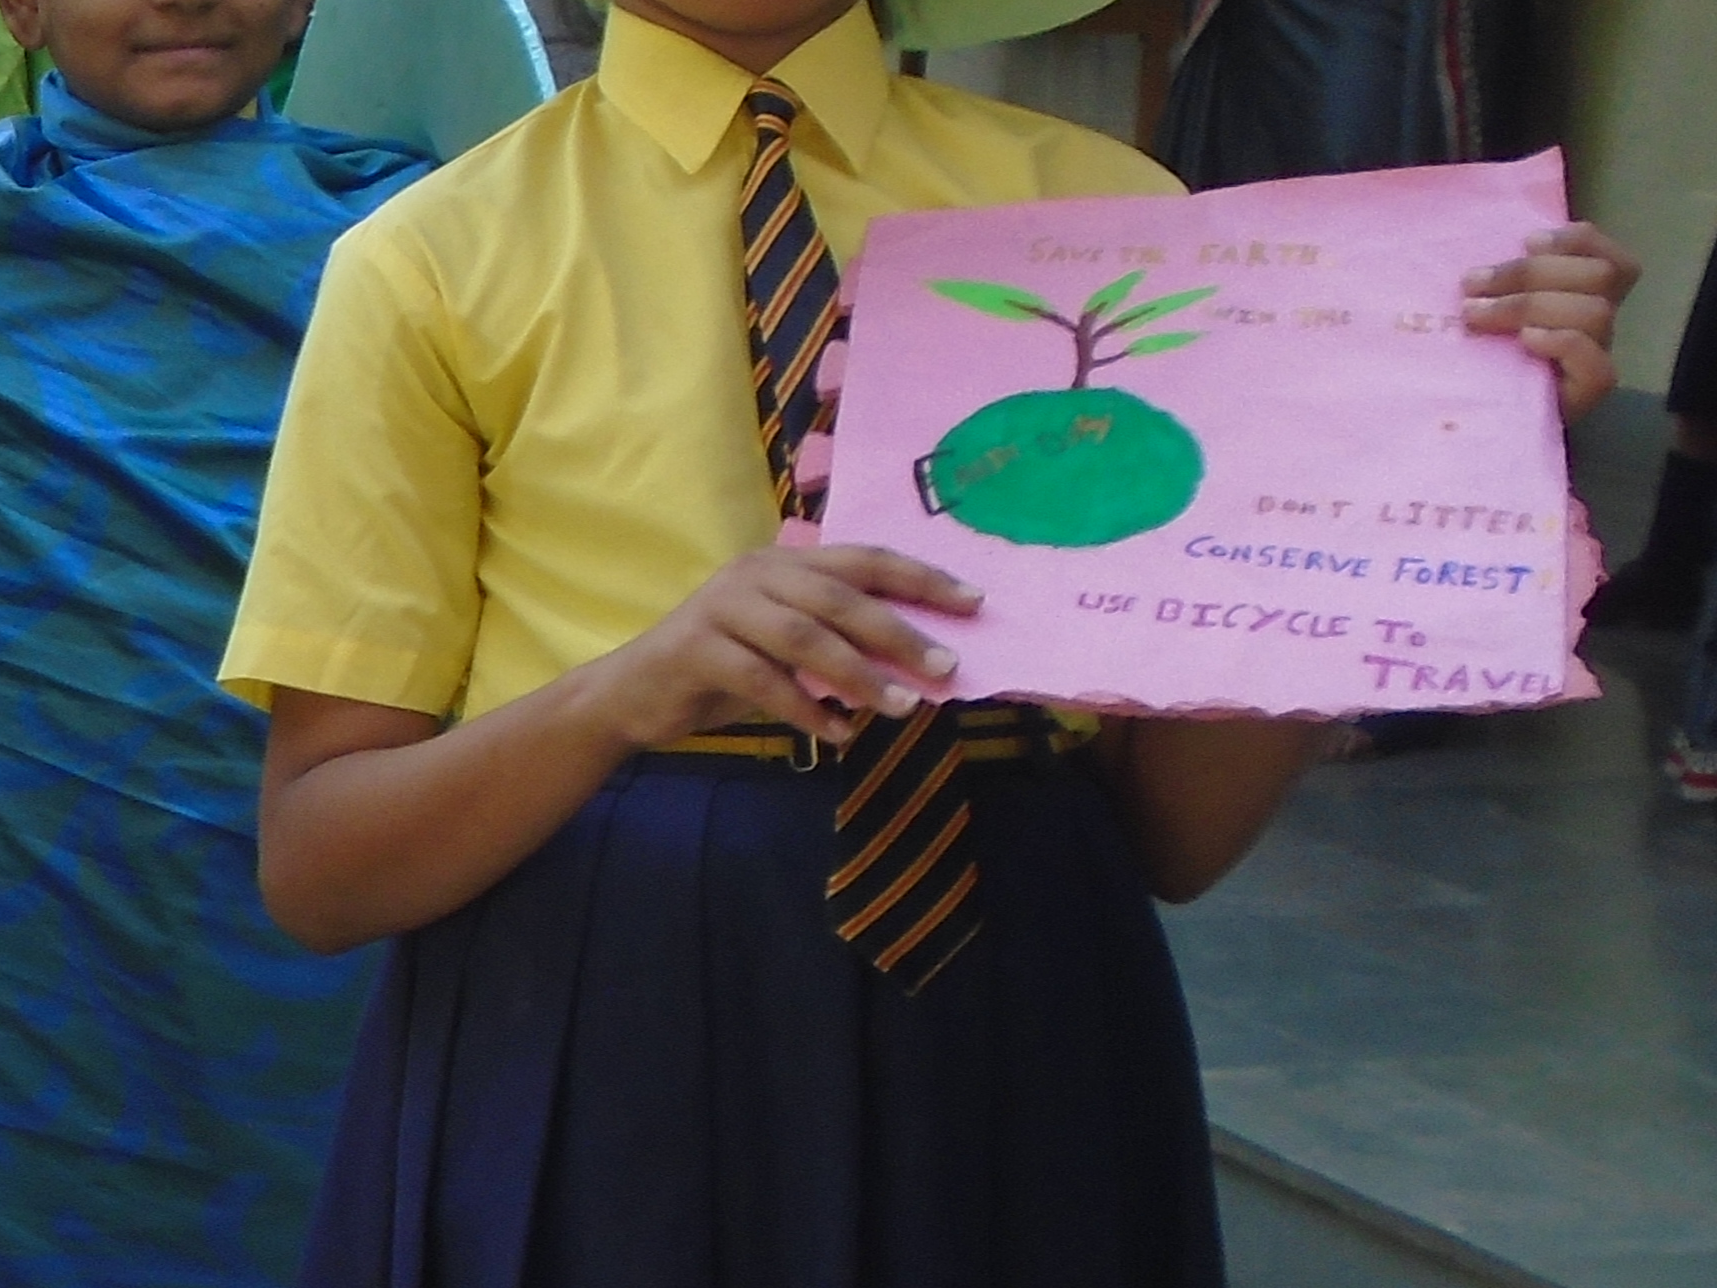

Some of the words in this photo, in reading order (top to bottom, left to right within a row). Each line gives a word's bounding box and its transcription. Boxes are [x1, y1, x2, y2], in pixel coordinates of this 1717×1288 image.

[1184, 535, 1371, 578] CONSERVE
[1156, 597, 1352, 638] BICYCLE
[1364, 653, 1564, 695] TRAVEL
